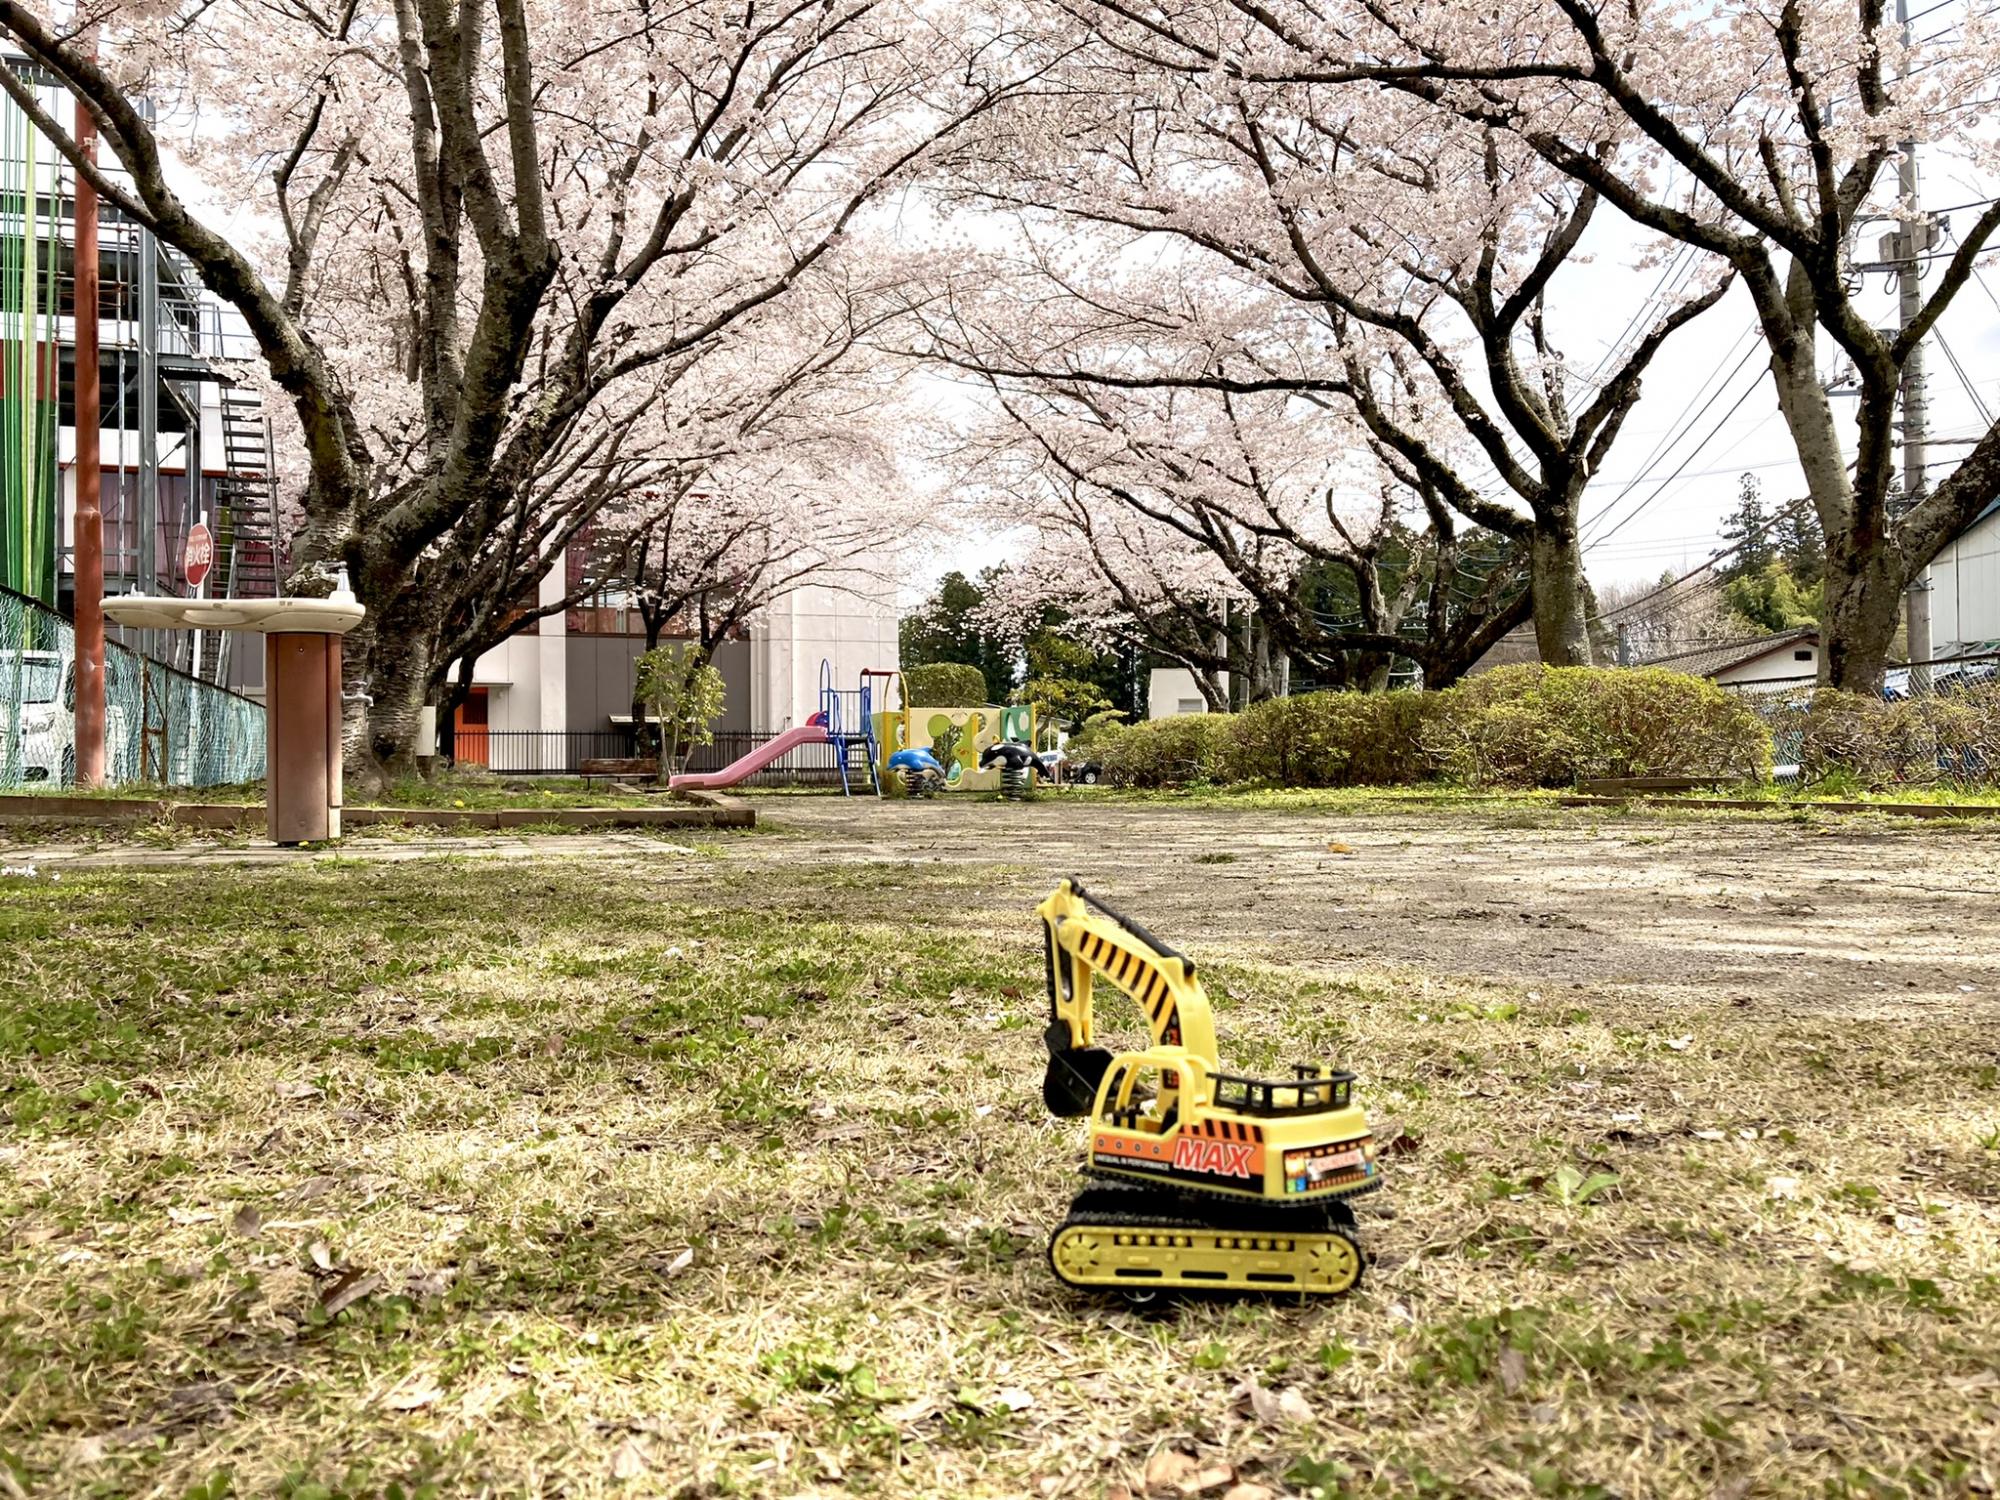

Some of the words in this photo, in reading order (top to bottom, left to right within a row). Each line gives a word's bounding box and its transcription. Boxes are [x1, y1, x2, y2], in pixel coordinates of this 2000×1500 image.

[186, 543, 210, 566] 消火栓
[1174, 1138, 1254, 1178] MAX
